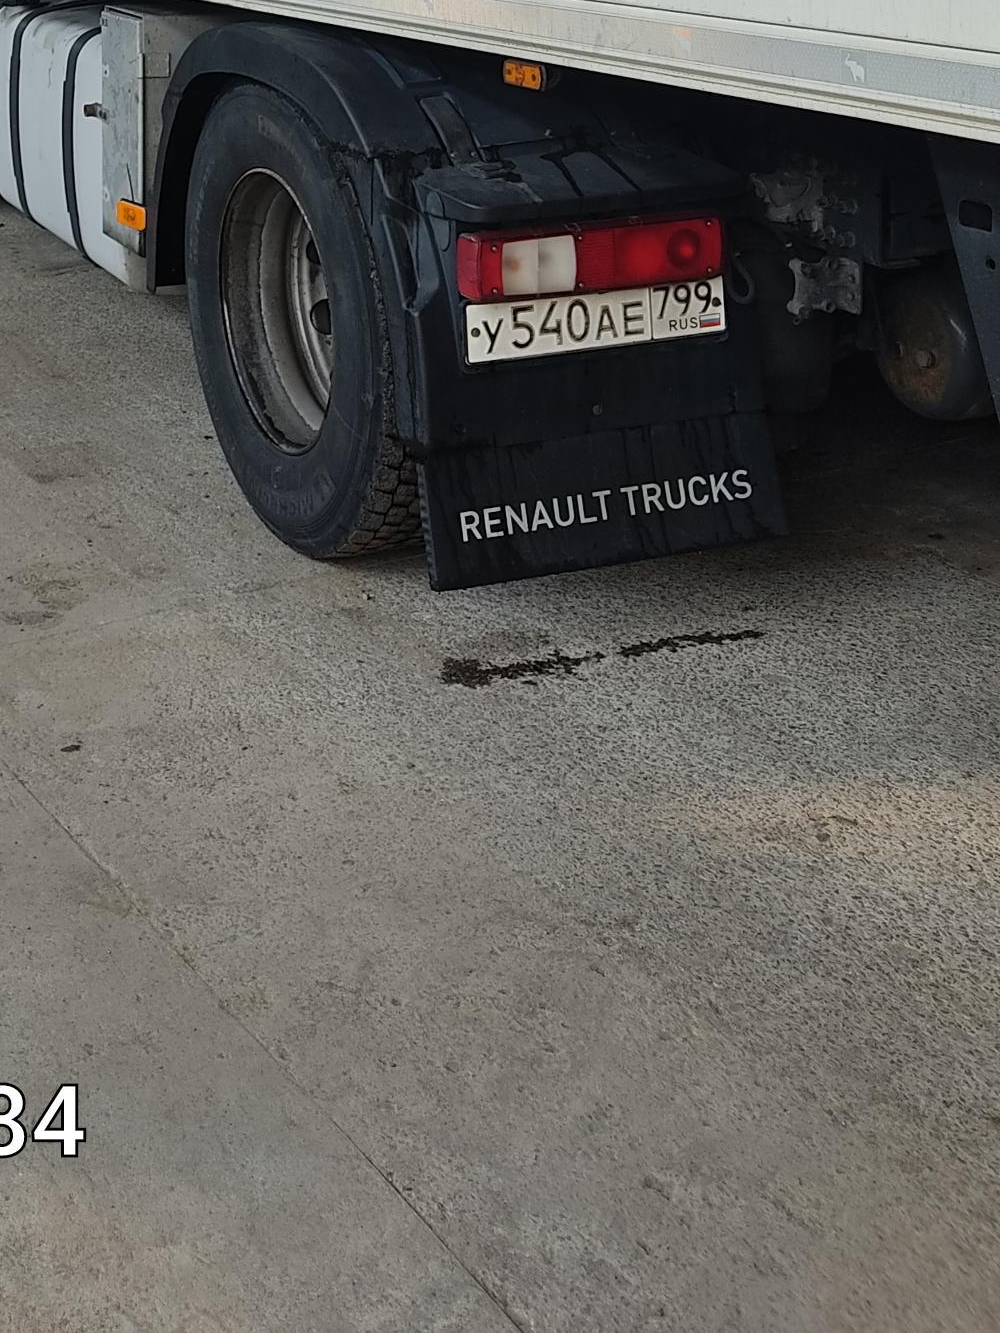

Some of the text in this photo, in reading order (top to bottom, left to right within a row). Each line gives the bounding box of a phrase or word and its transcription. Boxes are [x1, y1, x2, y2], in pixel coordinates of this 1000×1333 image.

[653, 282, 711, 319] 799
[668, 318, 699, 332] RUS
[459, 469, 753, 543] RENAULT TRUCKS
